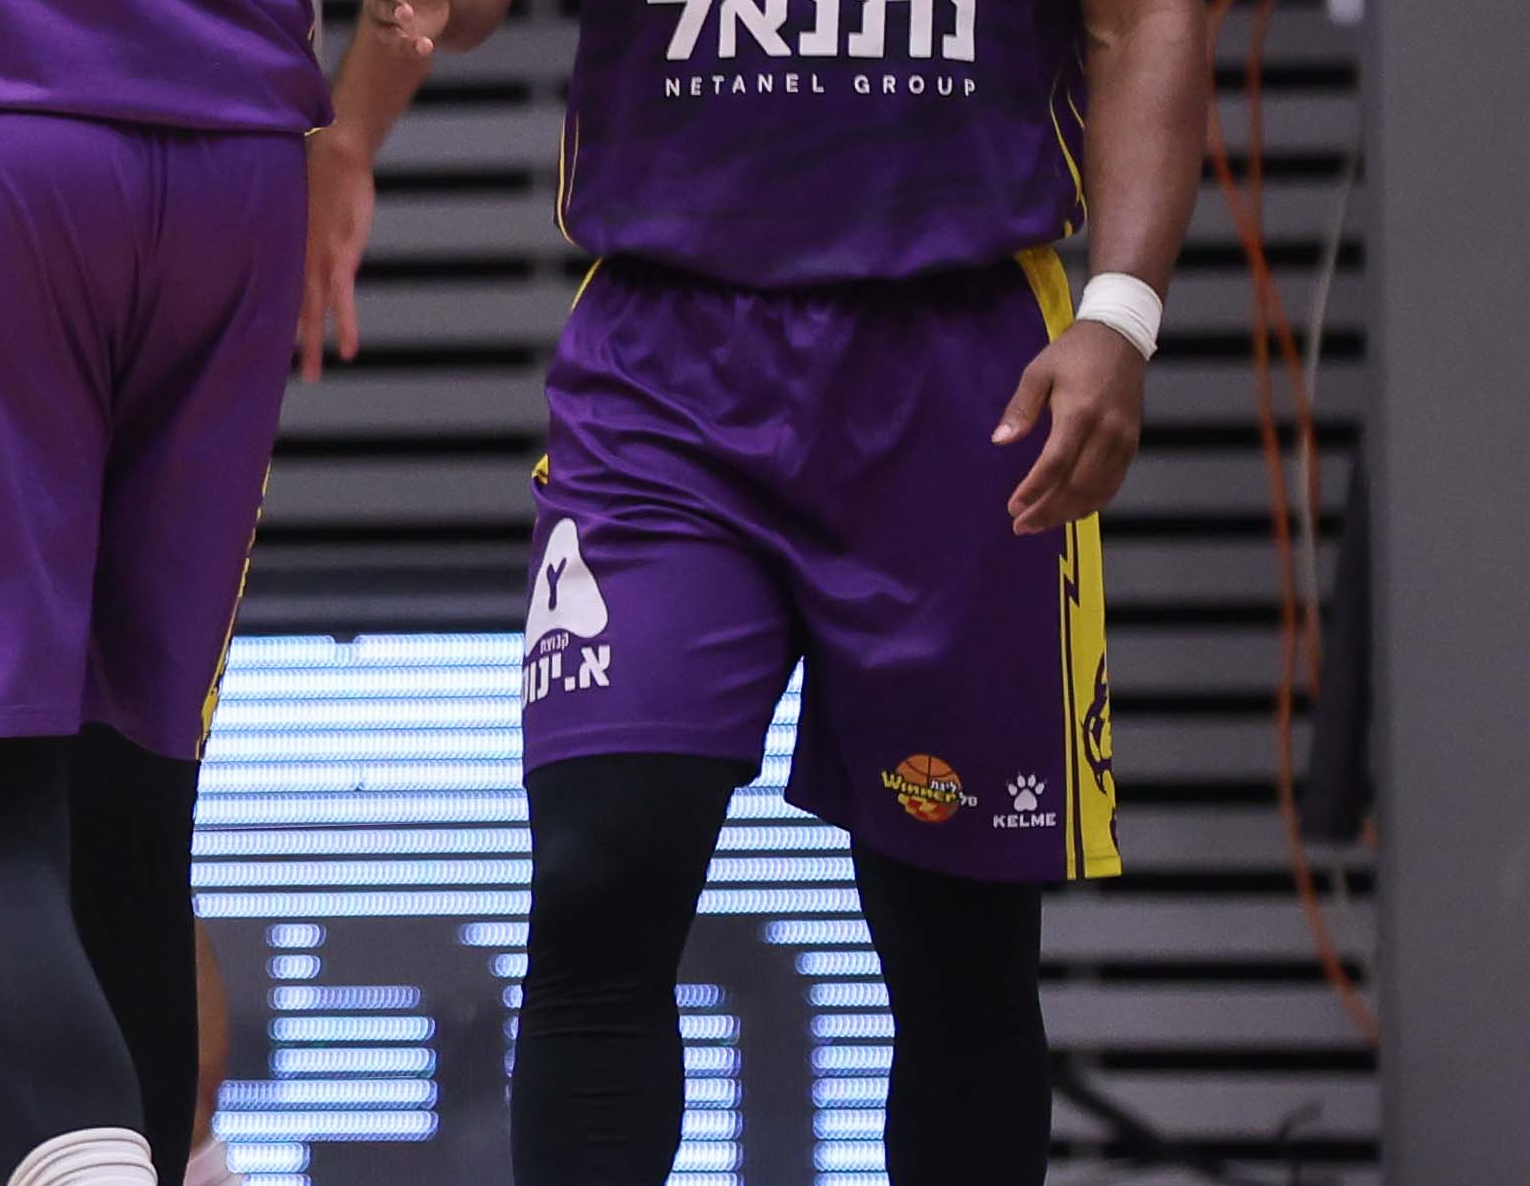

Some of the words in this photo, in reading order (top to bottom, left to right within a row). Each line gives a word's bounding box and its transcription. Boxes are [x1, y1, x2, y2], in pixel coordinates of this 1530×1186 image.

[665, 73, 825, 98] NETANEL
[853, 74, 977, 97] GROUP
[992, 812, 1057, 829] KELME
